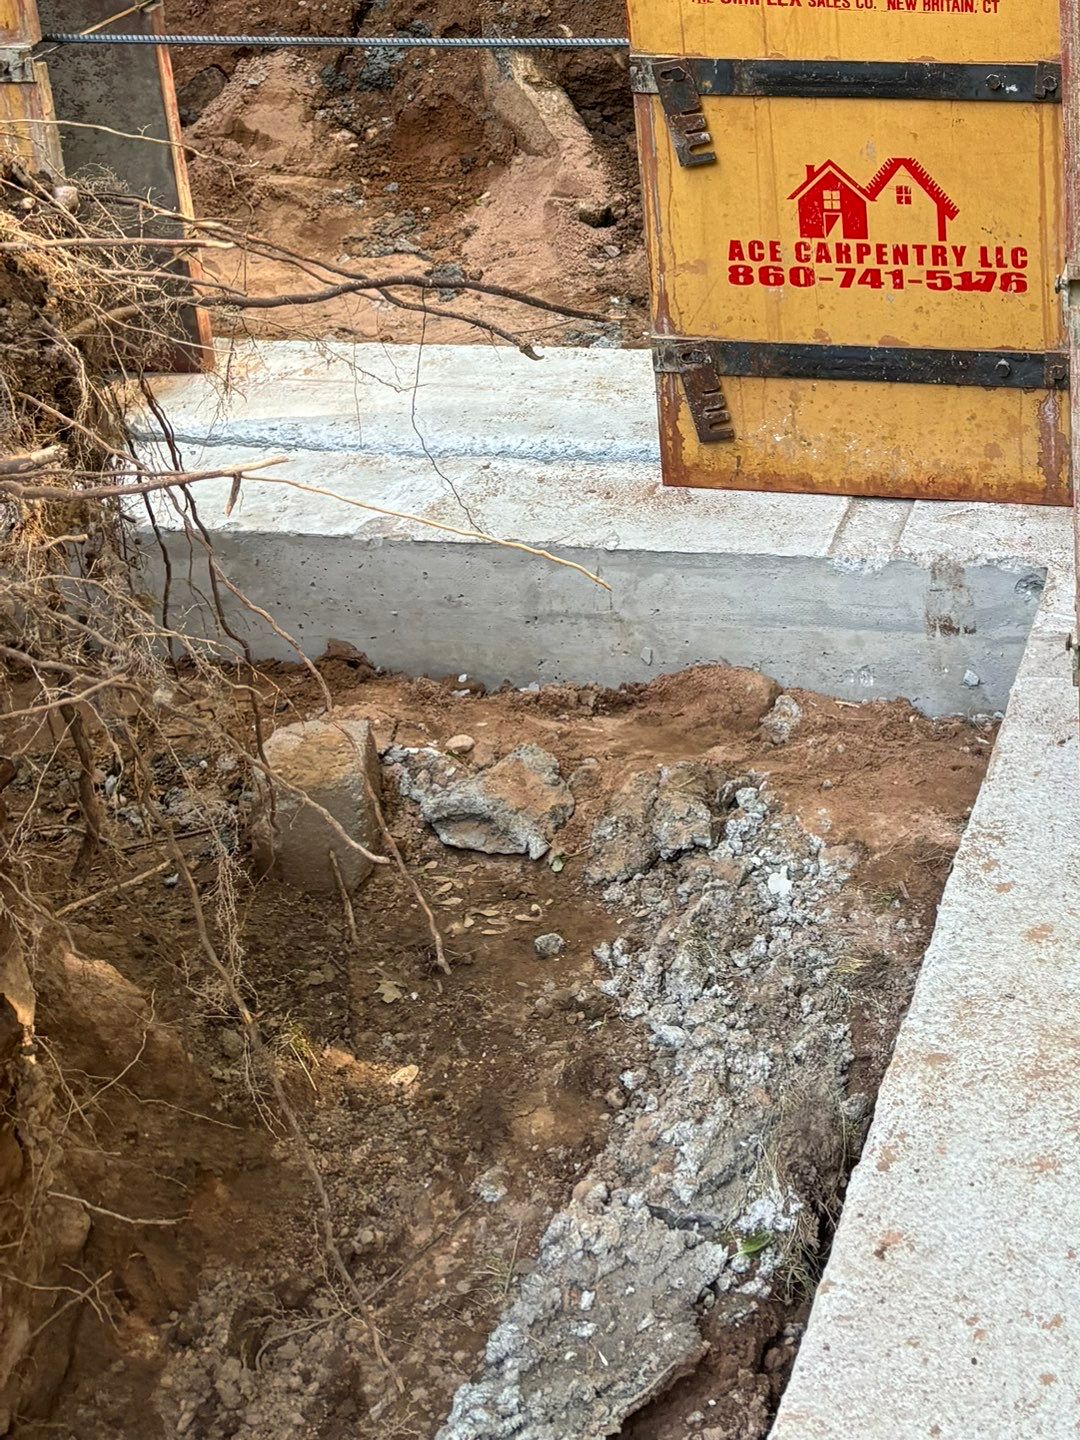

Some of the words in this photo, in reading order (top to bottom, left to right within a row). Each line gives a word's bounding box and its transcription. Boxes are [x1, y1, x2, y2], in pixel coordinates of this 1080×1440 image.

[728, 239, 782, 263] ACE
[794, 241, 967, 267] CARPENTRY
[979, 245, 1029, 268] LLC
[727, 264, 1029, 294] 860-741-5176
